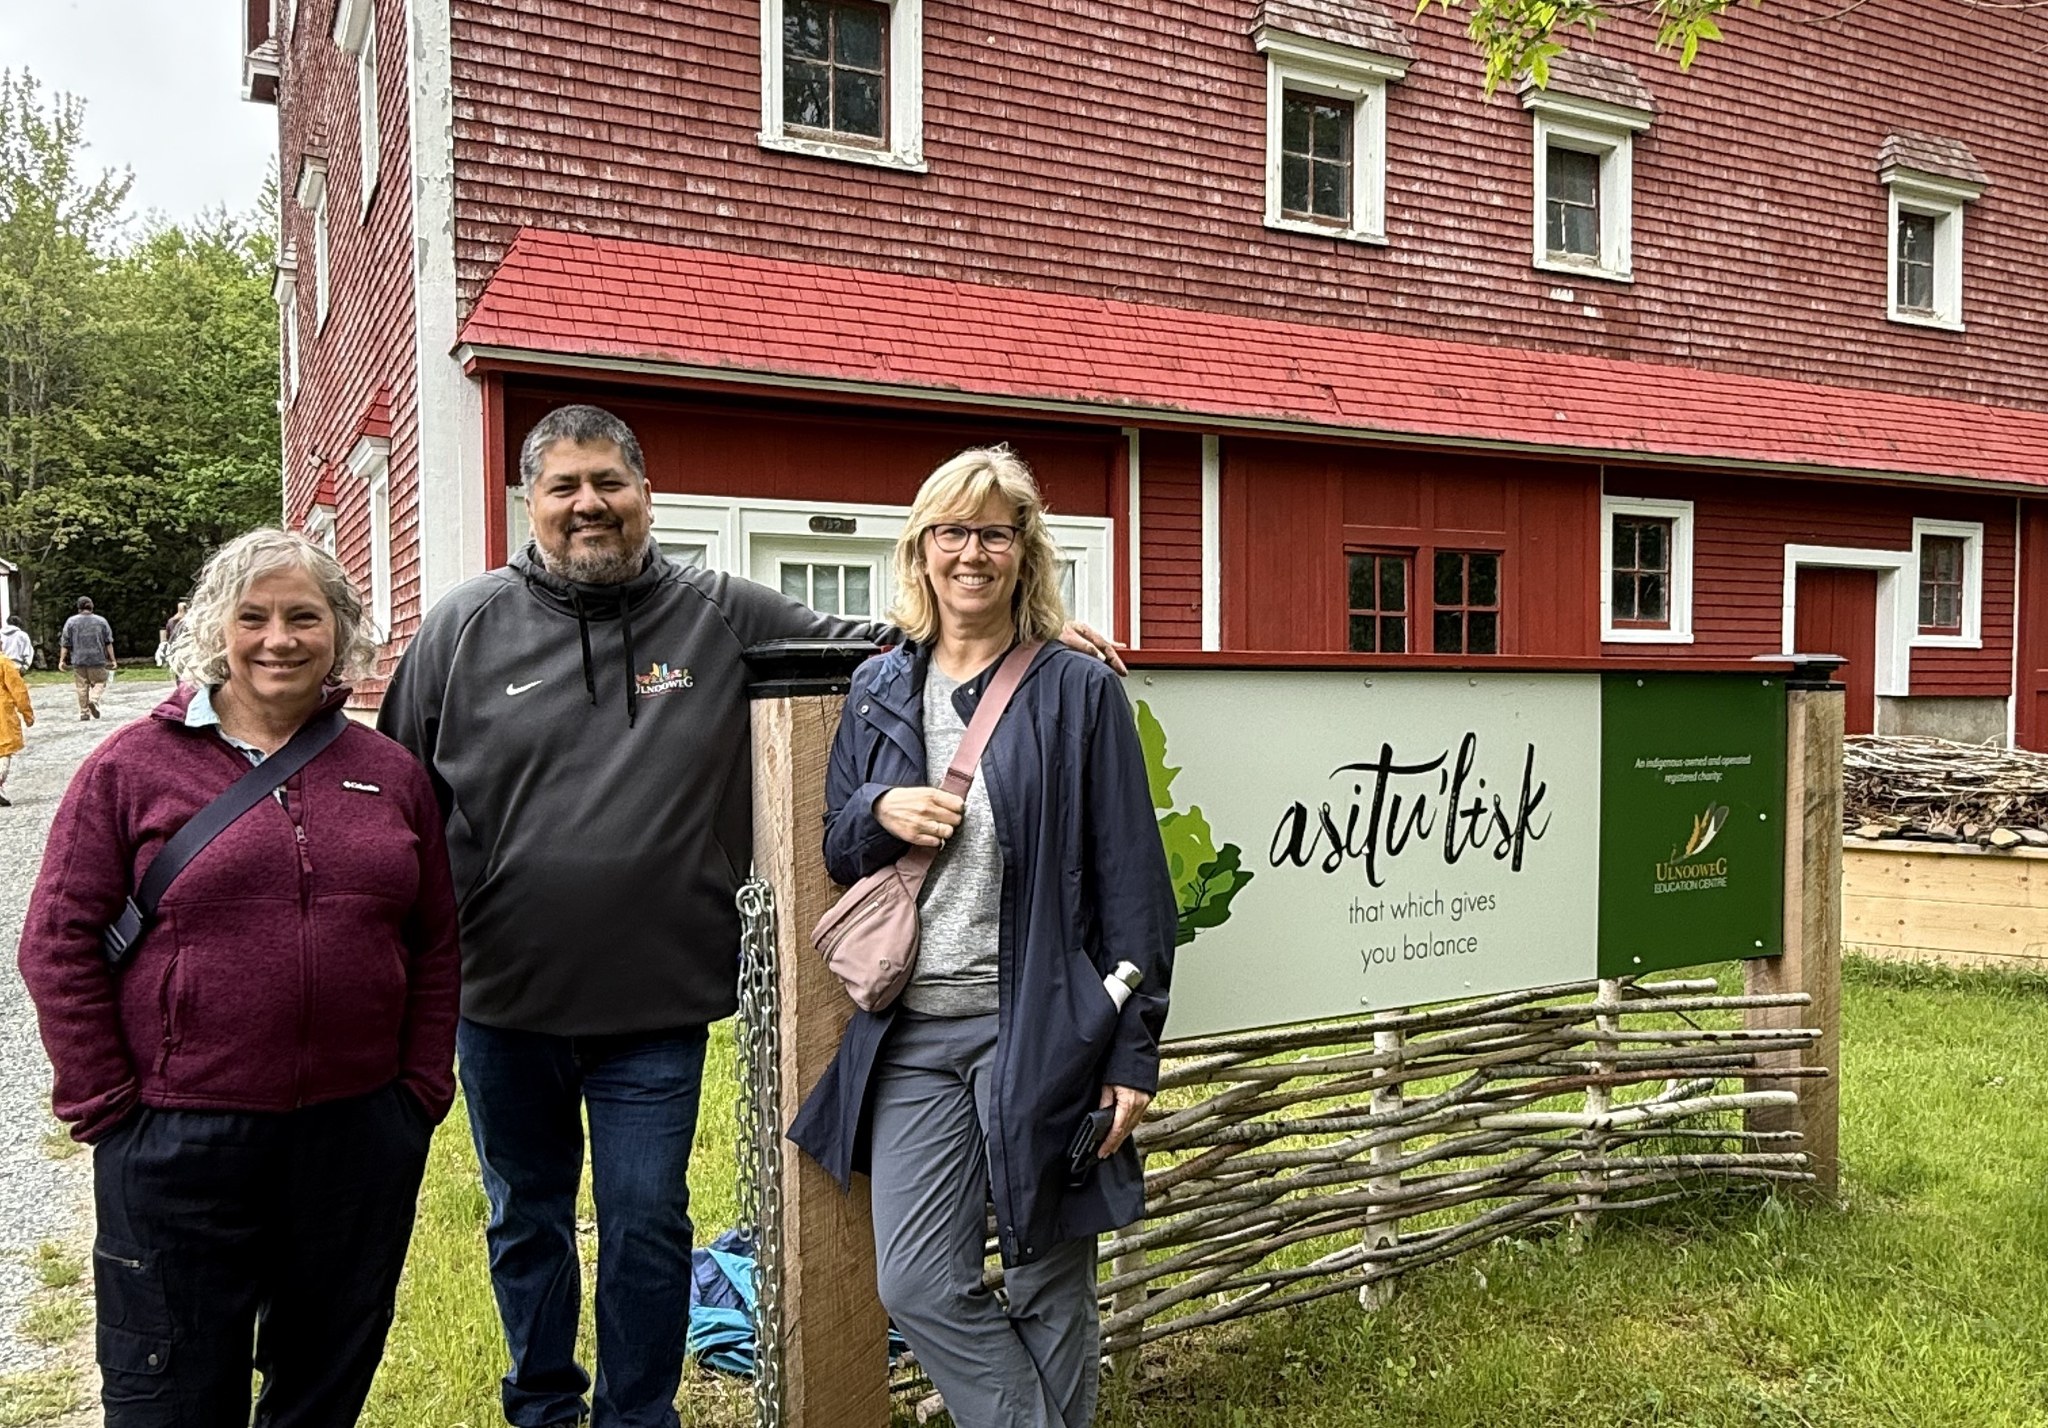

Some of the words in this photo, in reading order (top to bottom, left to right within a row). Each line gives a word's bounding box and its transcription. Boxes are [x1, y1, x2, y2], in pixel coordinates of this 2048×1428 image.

[1634, 757, 1646, 768] An
[1708, 755, 1721, 766] and
[1721, 754, 1751, 767] operated
[1664, 771, 1698, 785] registered
[1655, 857, 1727, 881] ULNOOWEG
[1654, 880, 1698, 894] EDUCATION
[1698, 876, 1728, 890] CENTRE
[1348, 895, 1385, 924] that
[1390, 889, 1444, 919] which
[1450, 890, 1496, 922] gives
[1360, 945, 1396, 974] you
[1403, 930, 1478, 960] balance
